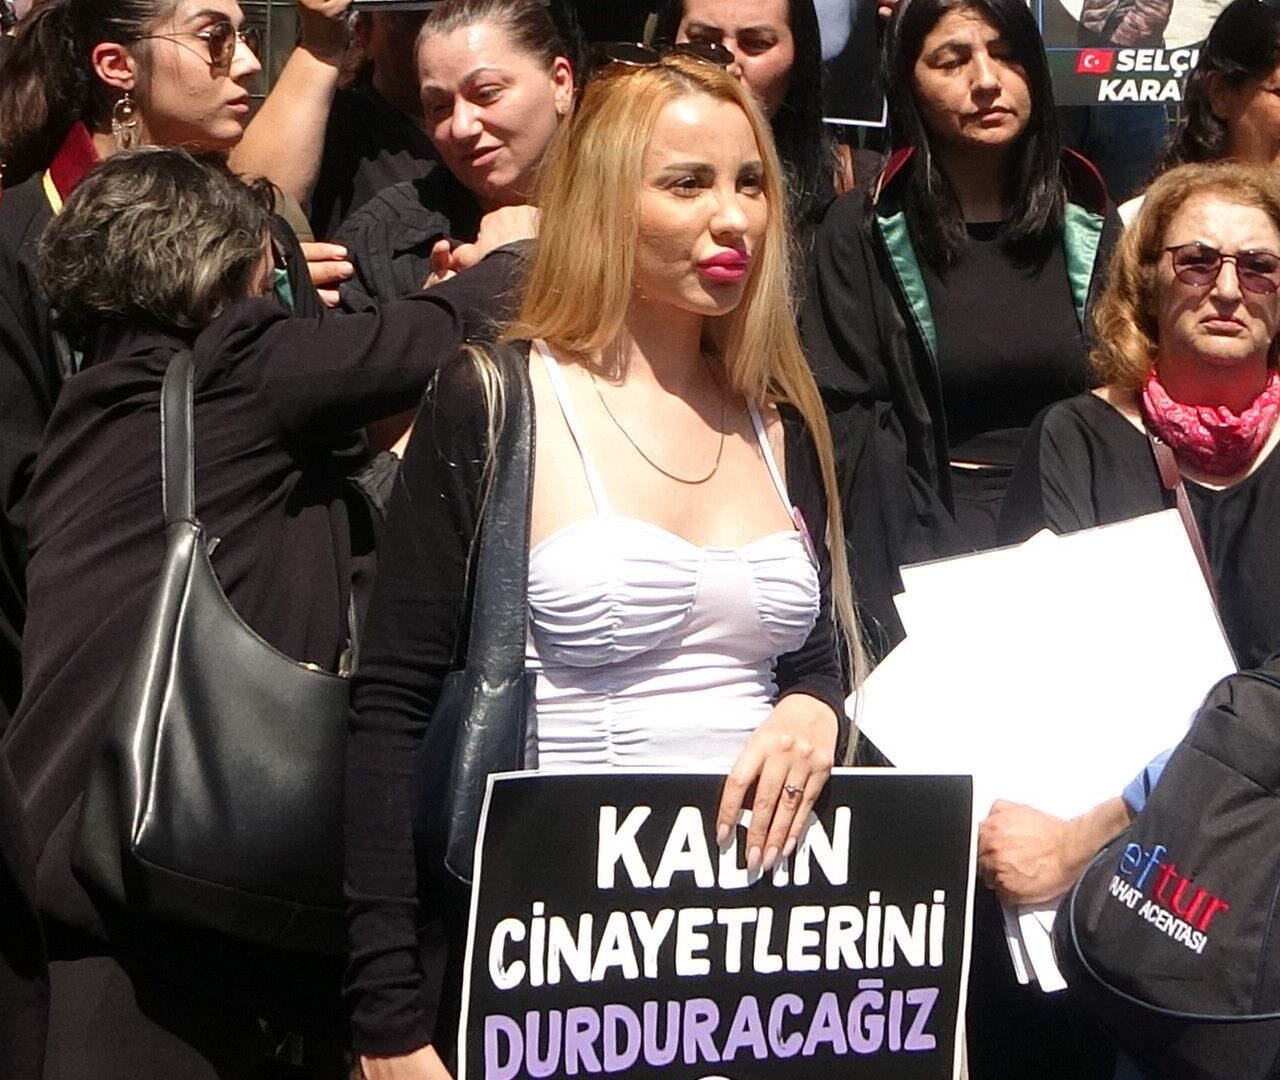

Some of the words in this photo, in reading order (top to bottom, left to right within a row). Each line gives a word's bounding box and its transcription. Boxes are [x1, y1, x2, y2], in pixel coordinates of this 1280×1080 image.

[596, 806, 852, 889] KADN
[488, 890, 946, 990] CİNAYETLERİNİ
[1109, 875, 1143, 909] AHAT
[1138, 900, 1207, 954] ACENTASI
[485, 978, 940, 1080] DURDURACAĞIZ
